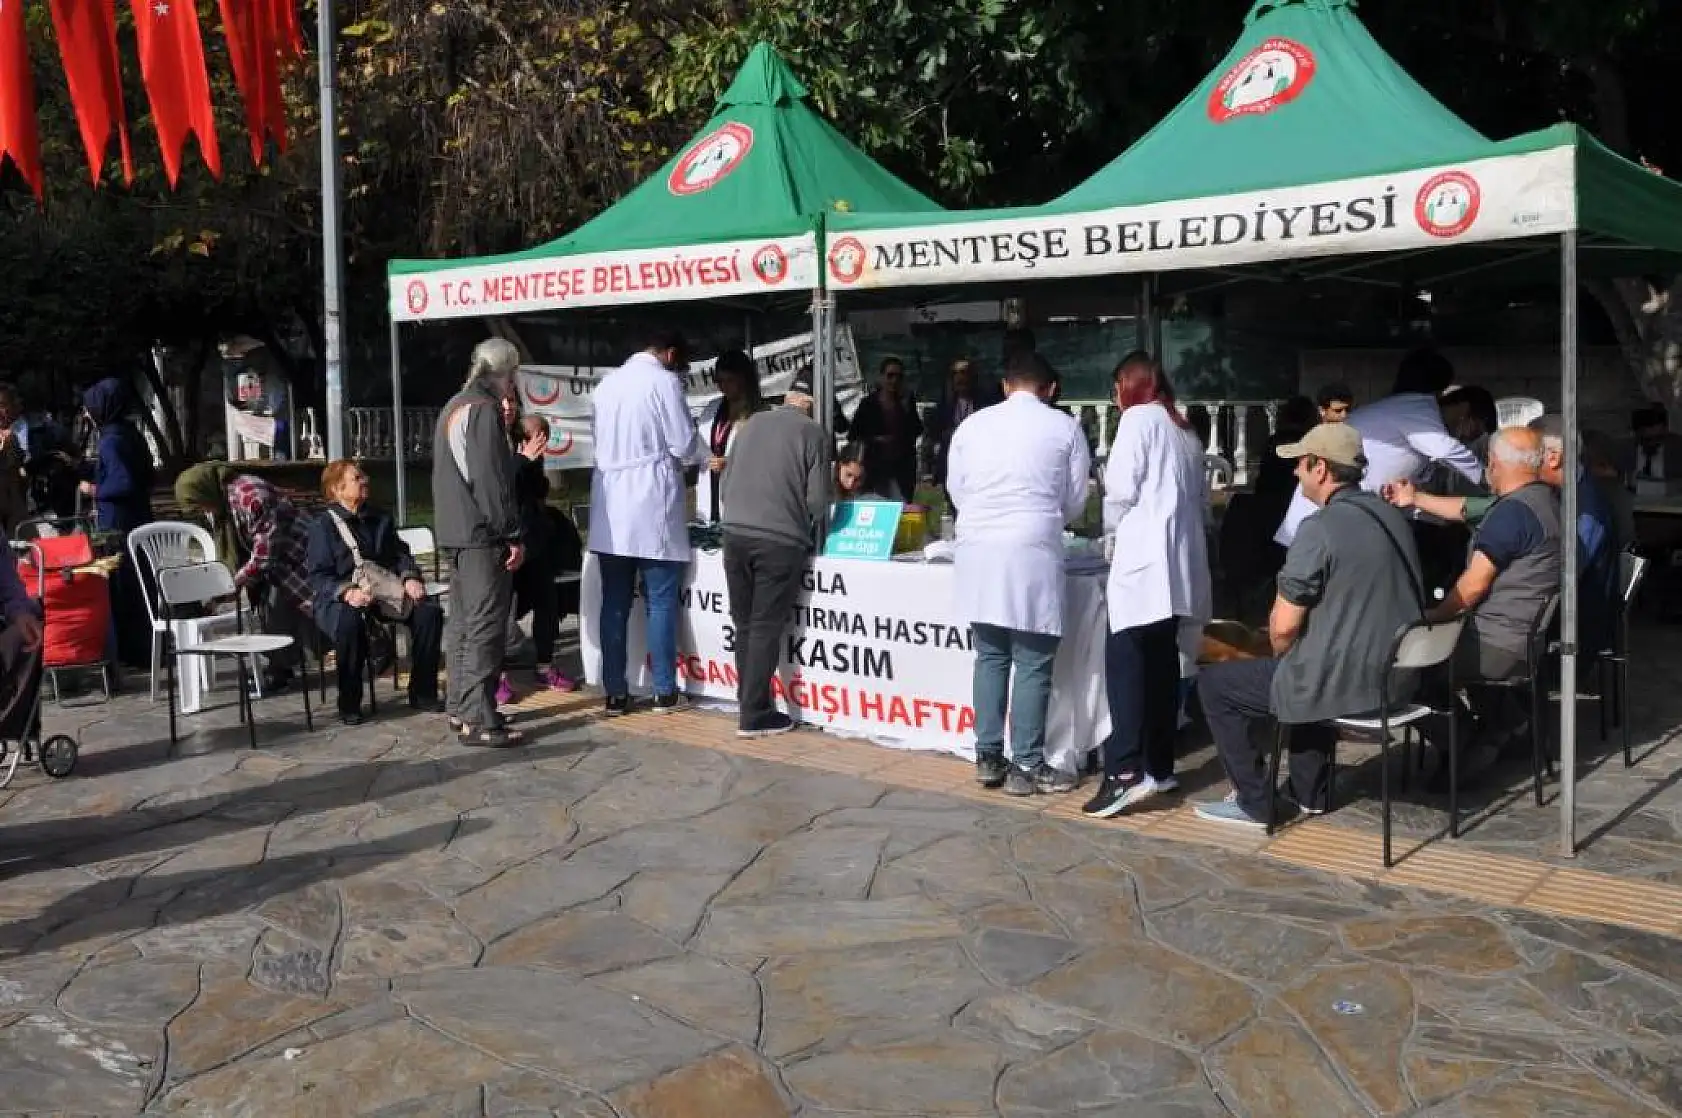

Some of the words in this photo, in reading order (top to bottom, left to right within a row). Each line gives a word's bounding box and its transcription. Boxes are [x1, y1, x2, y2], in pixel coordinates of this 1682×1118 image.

[874, 228, 1069, 269] MENTEŞE
[1083, 185, 1398, 257] BELEDİYESİ
[440, 279, 476, 307] T.C.
[482, 270, 584, 303] MENTEŞE
[593, 248, 742, 293] BELEDİYESİ
[697, 589, 723, 613] VE
[791, 604, 868, 638] TIRMA
[787, 634, 894, 681] KASIM
[769, 671, 850, 723] AĞIŞI
[859, 690, 976, 735] HAFTA
